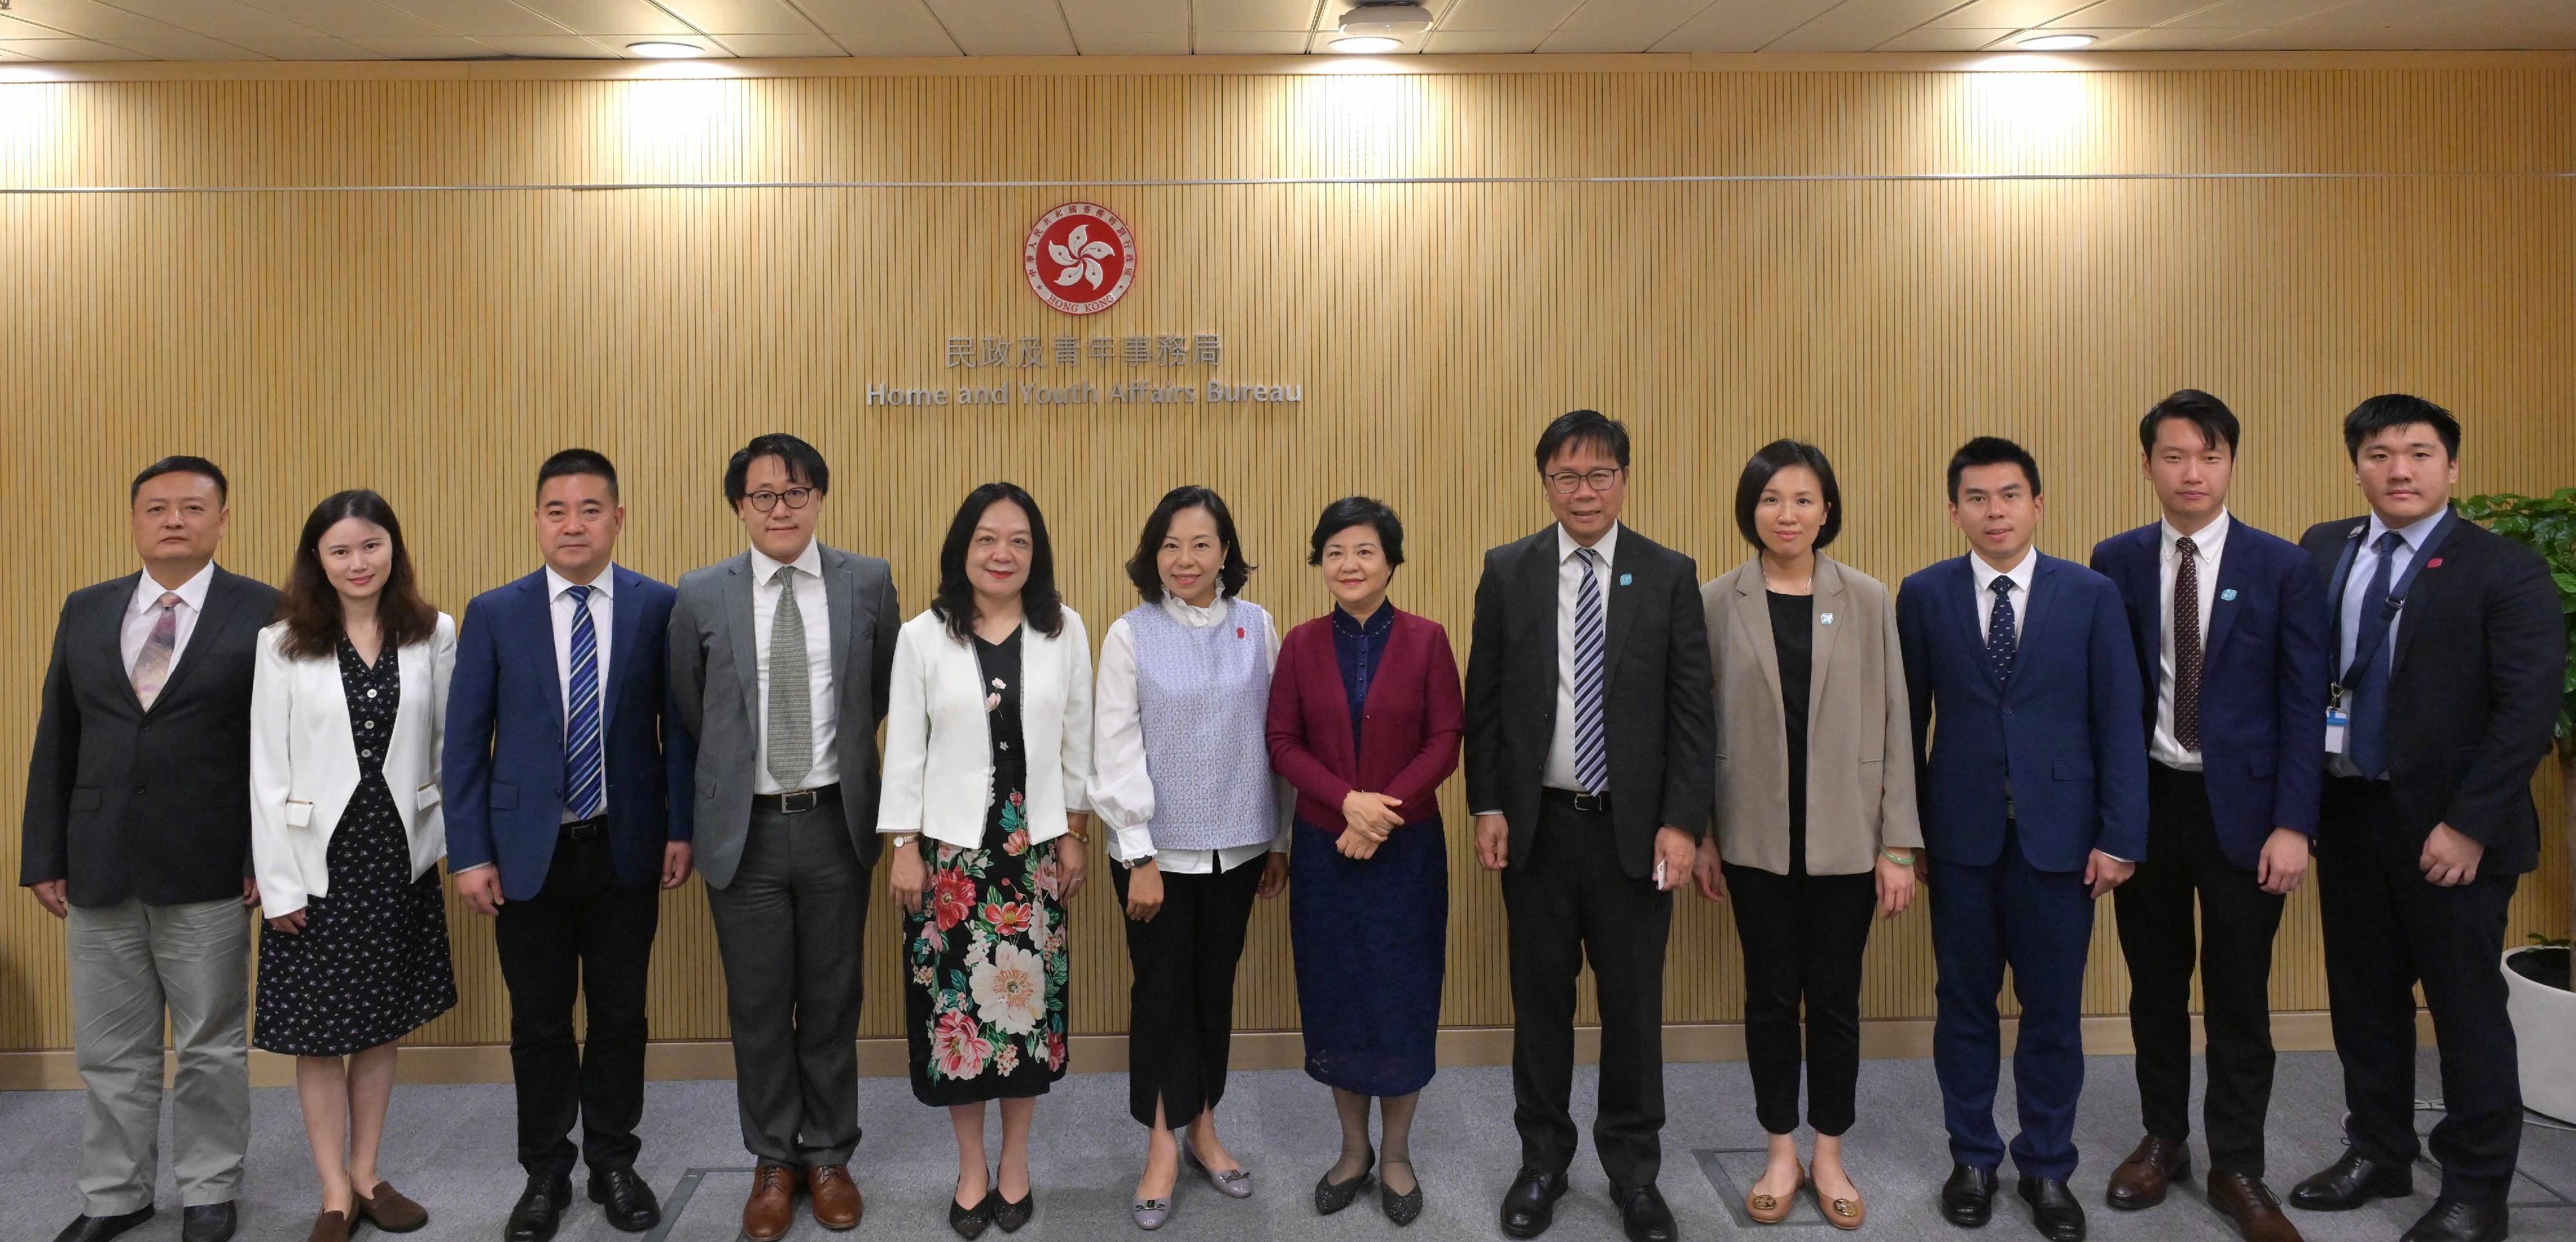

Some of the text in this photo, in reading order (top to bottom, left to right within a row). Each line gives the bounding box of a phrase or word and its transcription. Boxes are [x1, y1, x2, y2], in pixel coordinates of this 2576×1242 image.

[1047, 294, 1115, 312] HONG KONG
[947, 334, 1221, 368] 民政及青年事務局
[867, 379, 1302, 406] Home and Youth Affairs Bureau
